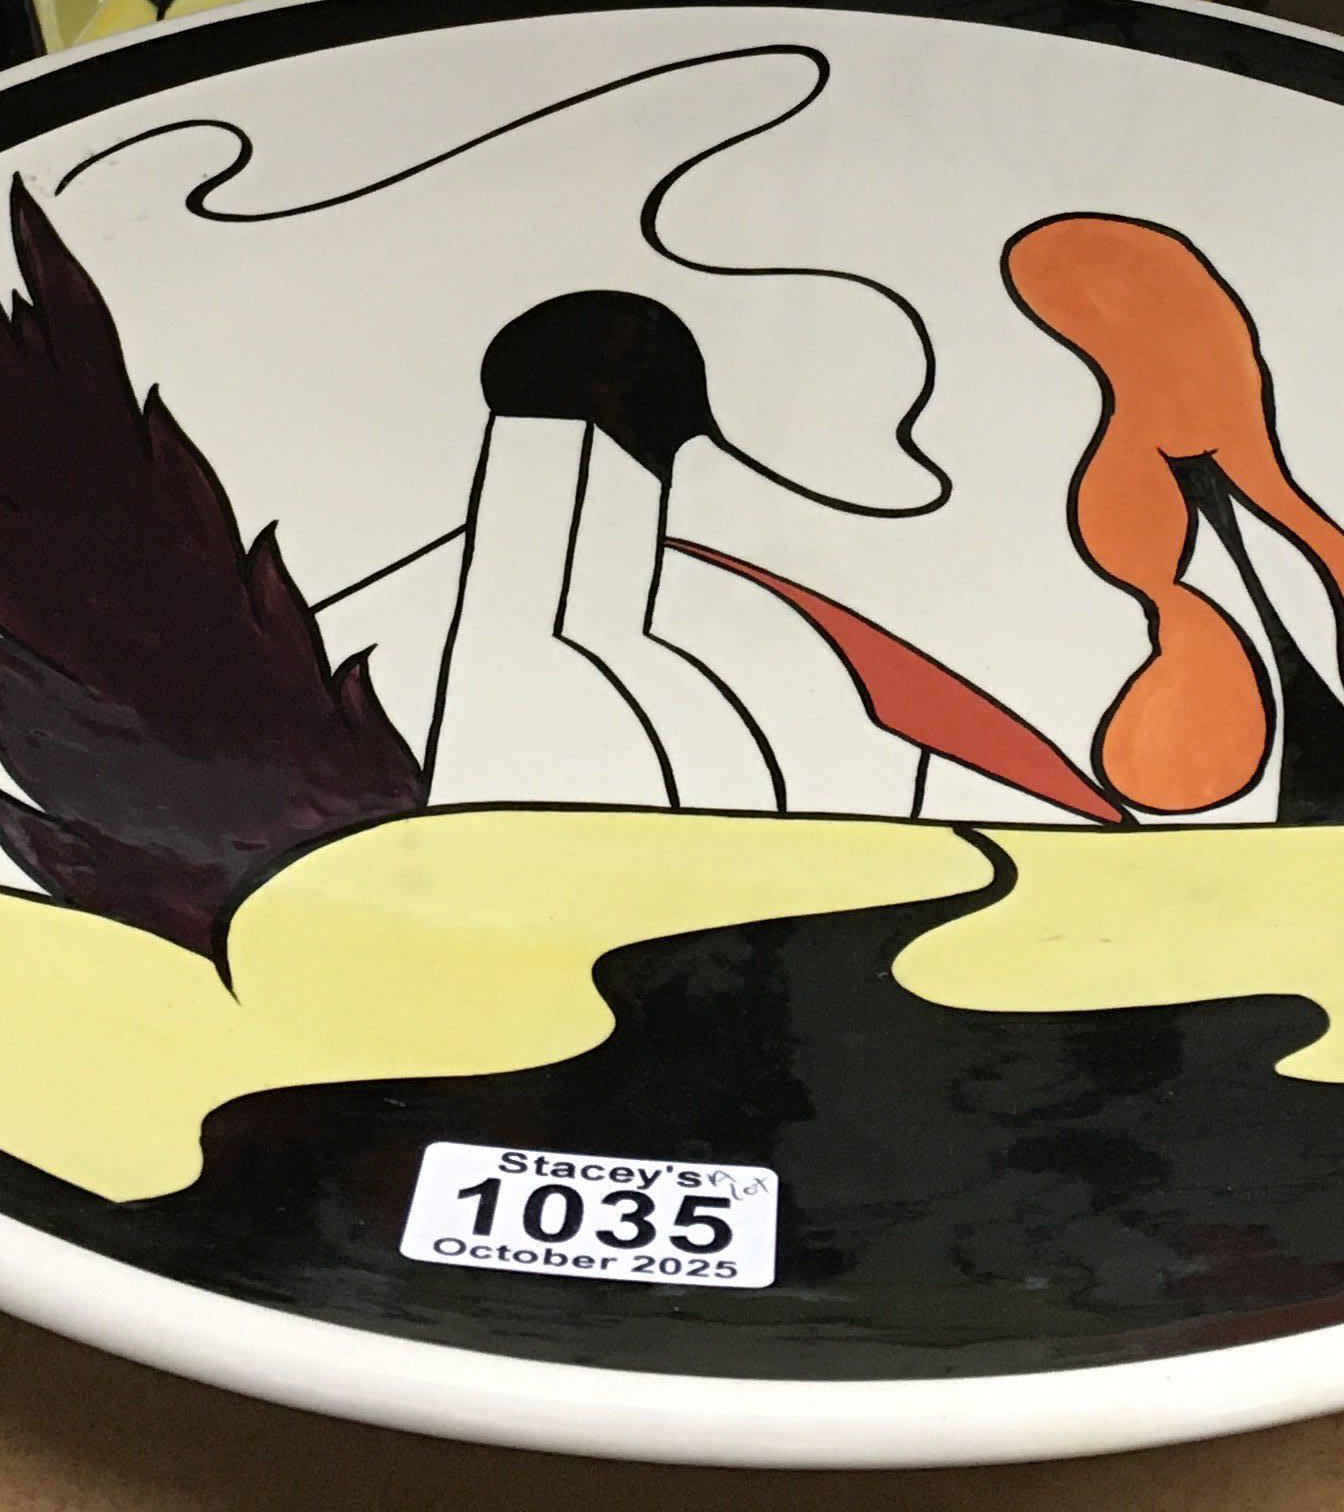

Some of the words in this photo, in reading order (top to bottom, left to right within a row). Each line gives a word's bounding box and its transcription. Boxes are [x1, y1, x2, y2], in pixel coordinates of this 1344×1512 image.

[498, 1151, 703, 1190] Stacey's
[457, 1177, 733, 1255] 1035
[432, 1237, 618, 1271] October
[630, 1254, 739, 1279] 2025
